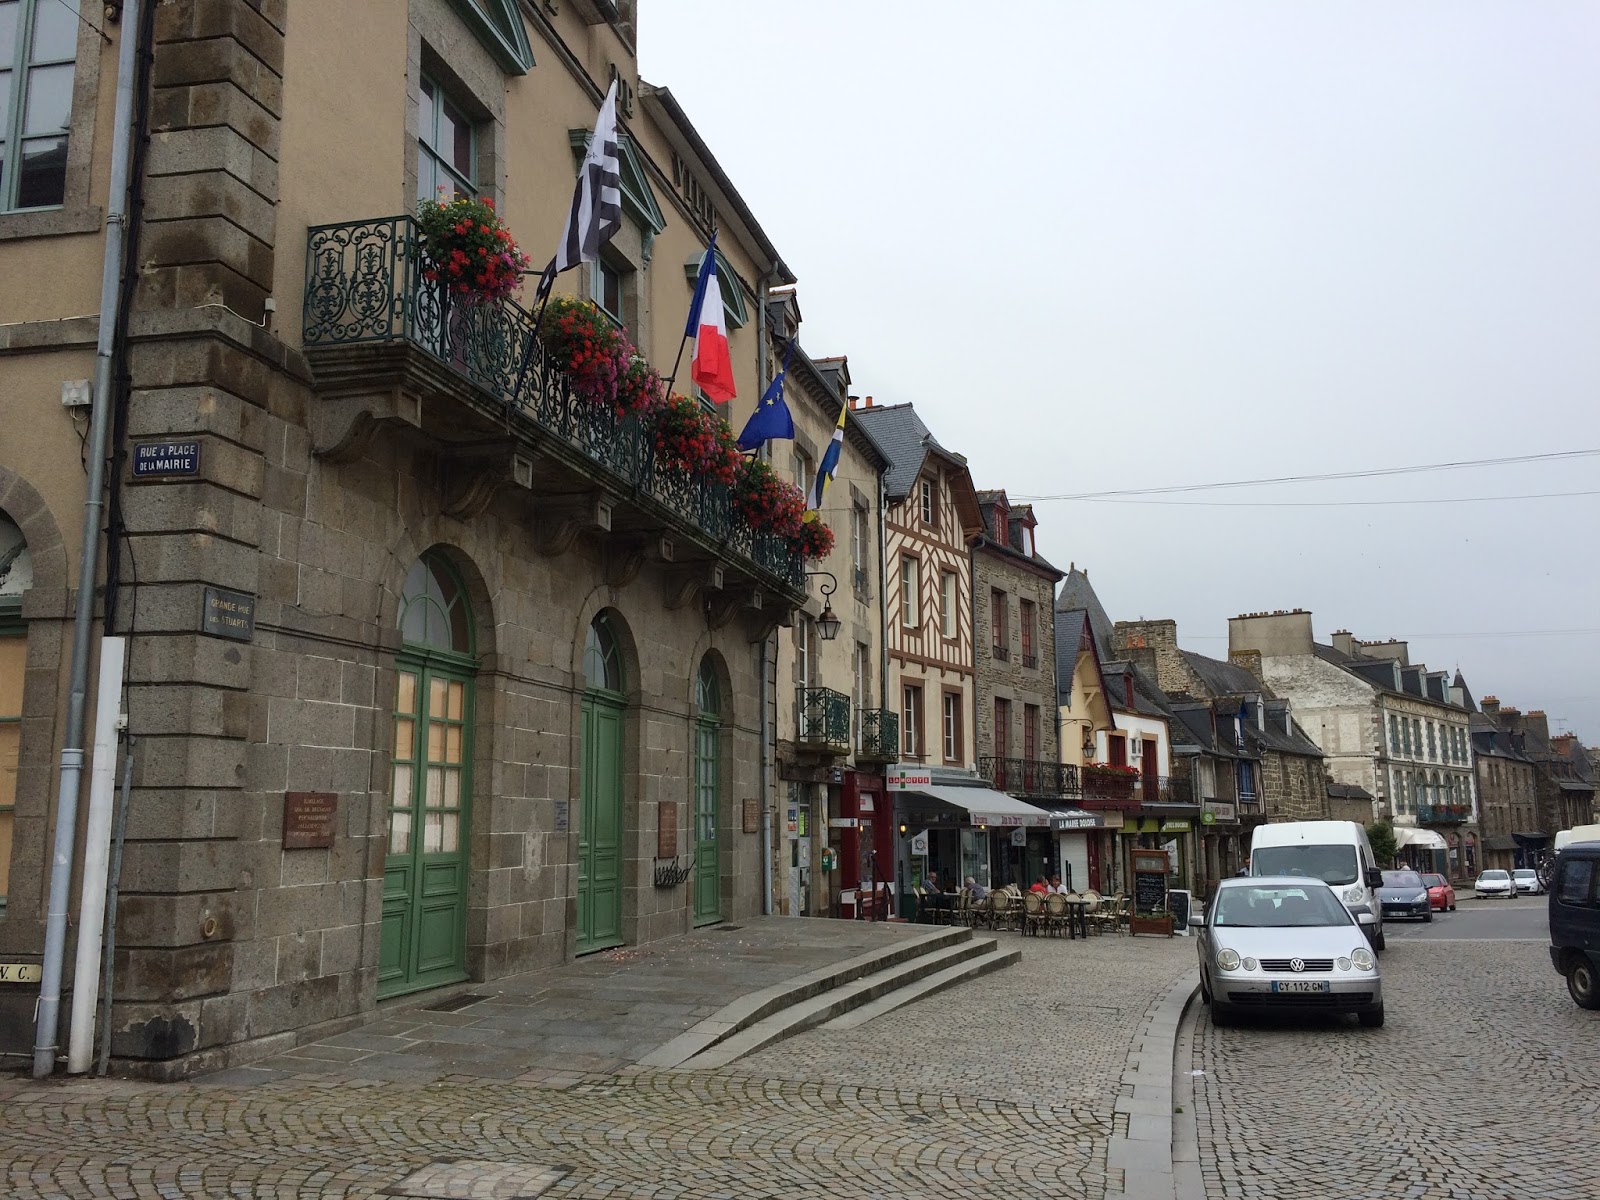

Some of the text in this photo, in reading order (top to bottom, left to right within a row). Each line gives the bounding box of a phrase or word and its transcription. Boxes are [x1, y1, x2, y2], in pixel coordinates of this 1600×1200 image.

[140, 444, 196, 457] RUE & PLACE
[139, 458, 191, 471] DE LA MAIRIE
[210, 598, 250, 615] GRANDE RUE
[221, 615, 249, 629] STUARTS
[1058, 819, 1065, 829] LA
[18, 966, 30, 980] C.
